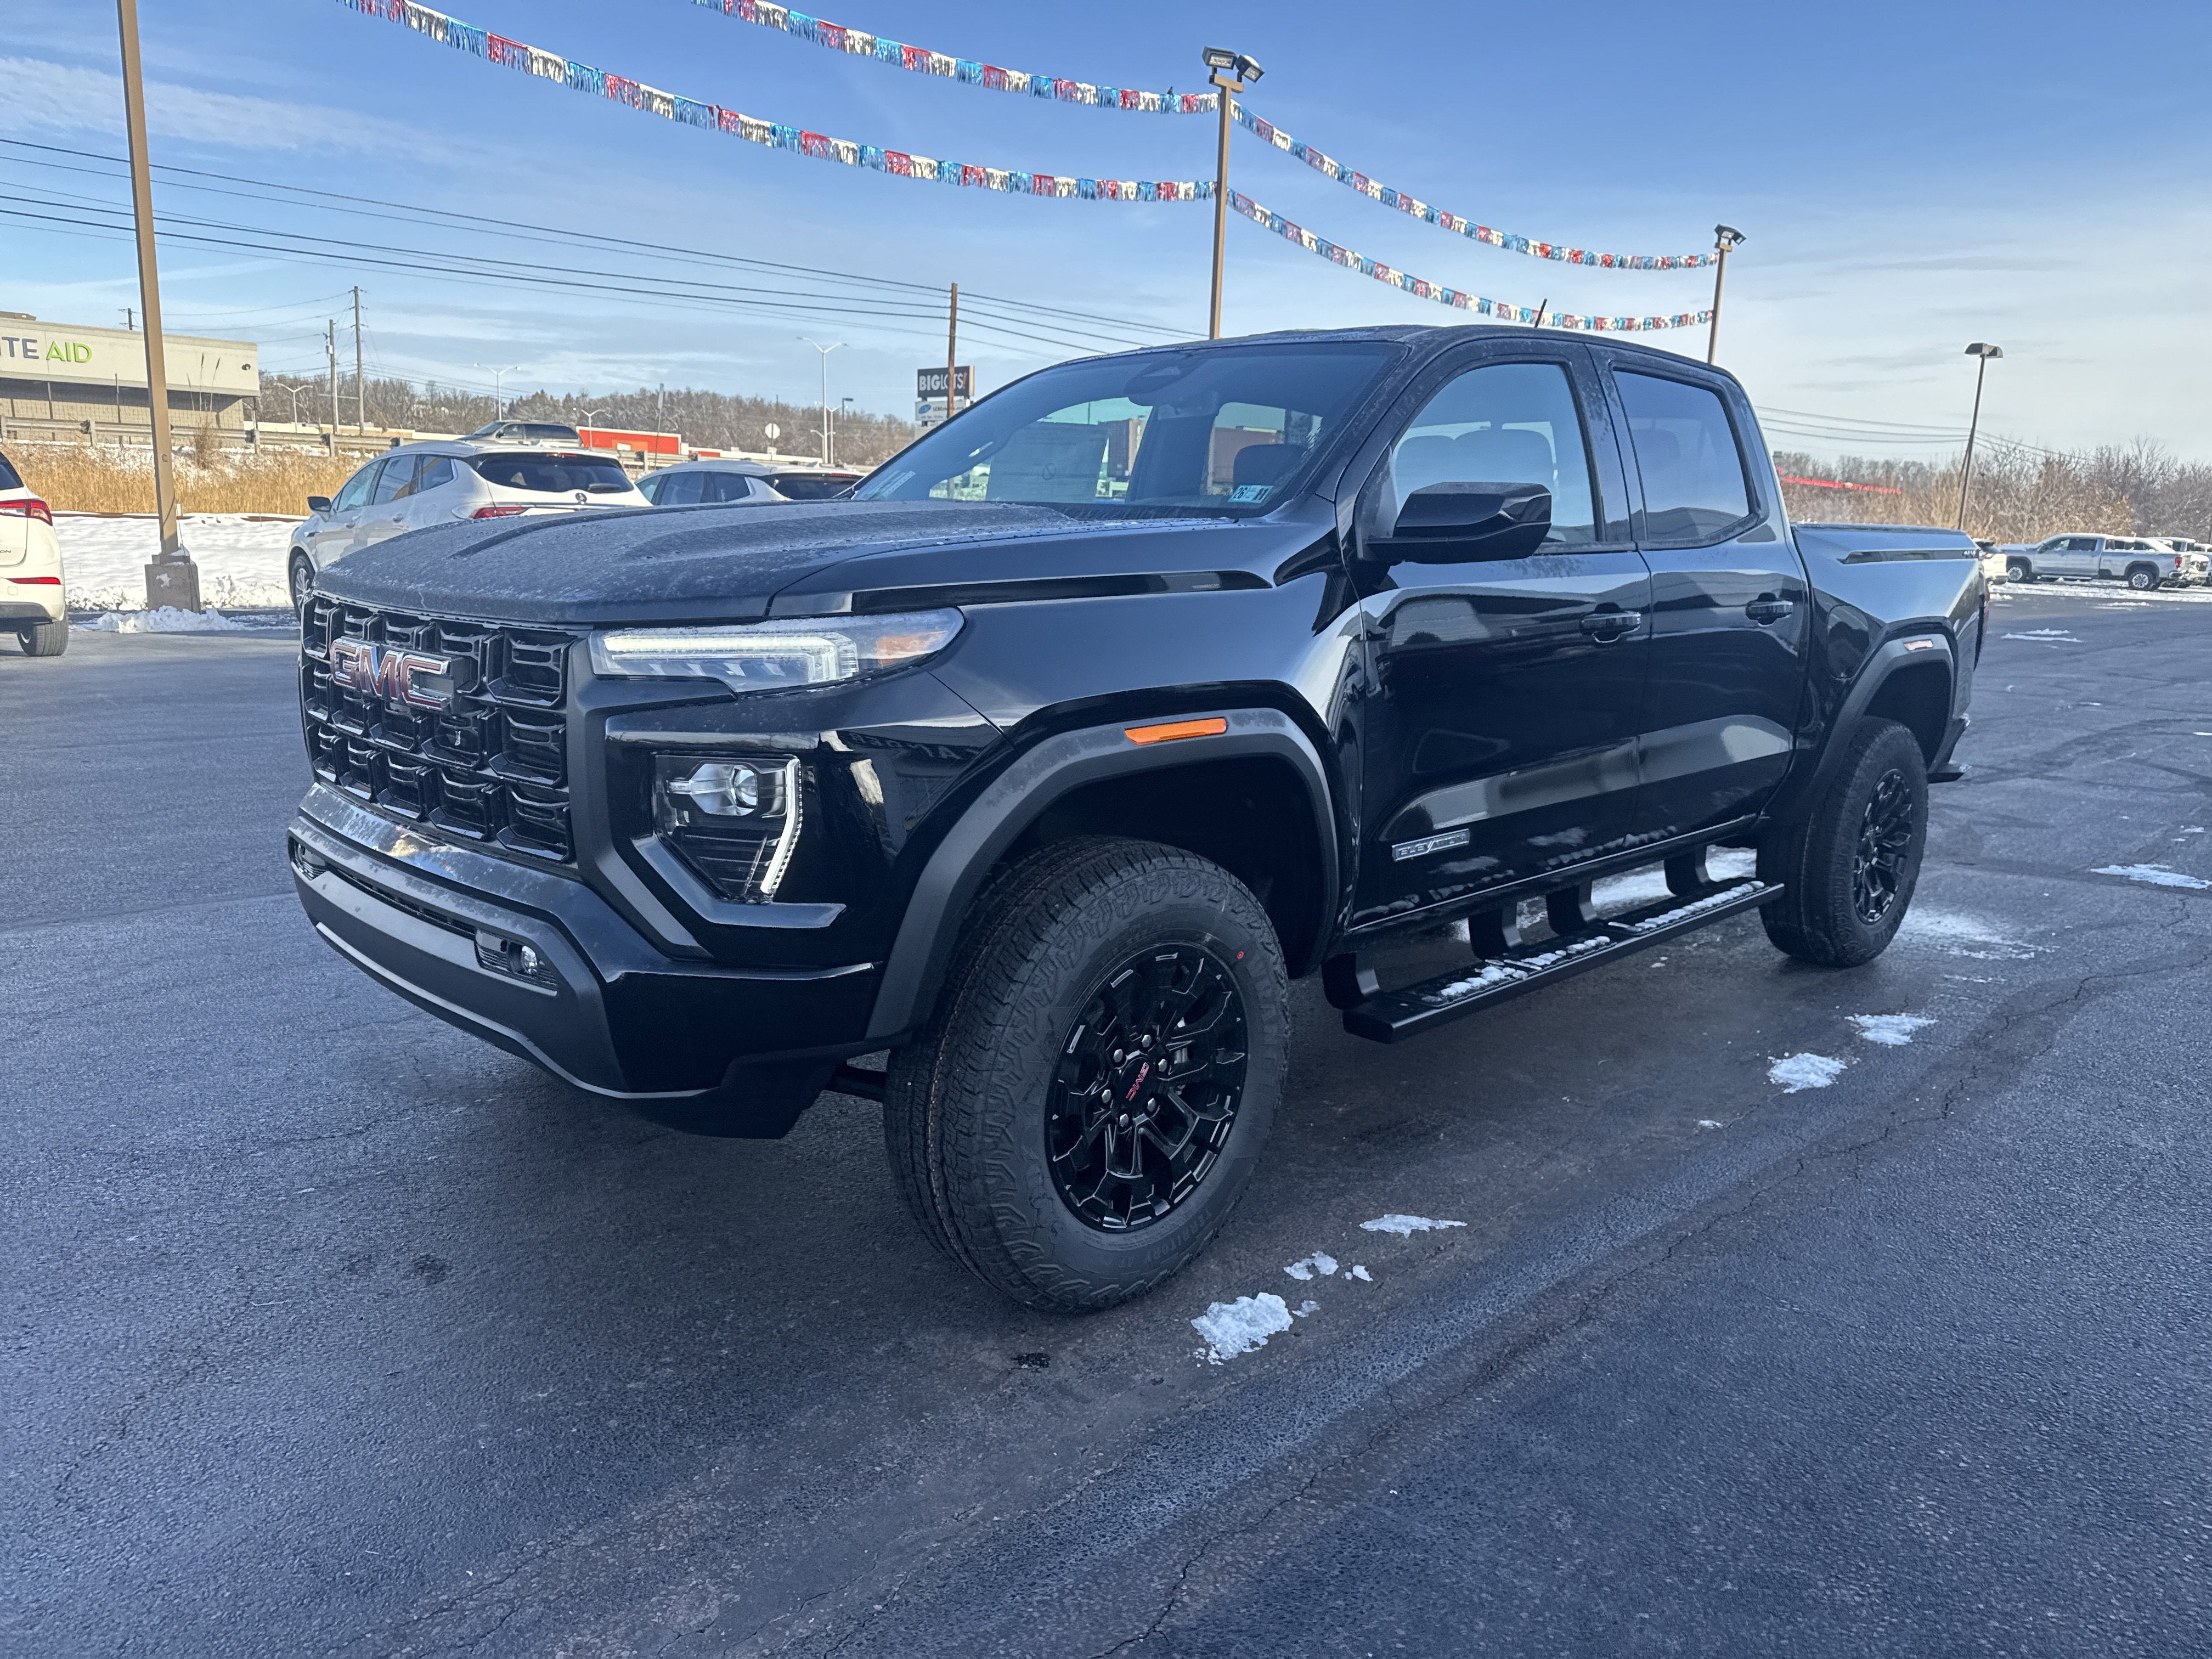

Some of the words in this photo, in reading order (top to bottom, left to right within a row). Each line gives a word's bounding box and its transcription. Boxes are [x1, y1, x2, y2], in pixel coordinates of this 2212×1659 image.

[0, 336, 39, 359] TE
[46, 341, 93, 363] AID
[330, 638, 452, 711] GMC
[1125, 1062, 1149, 1102] GMC
